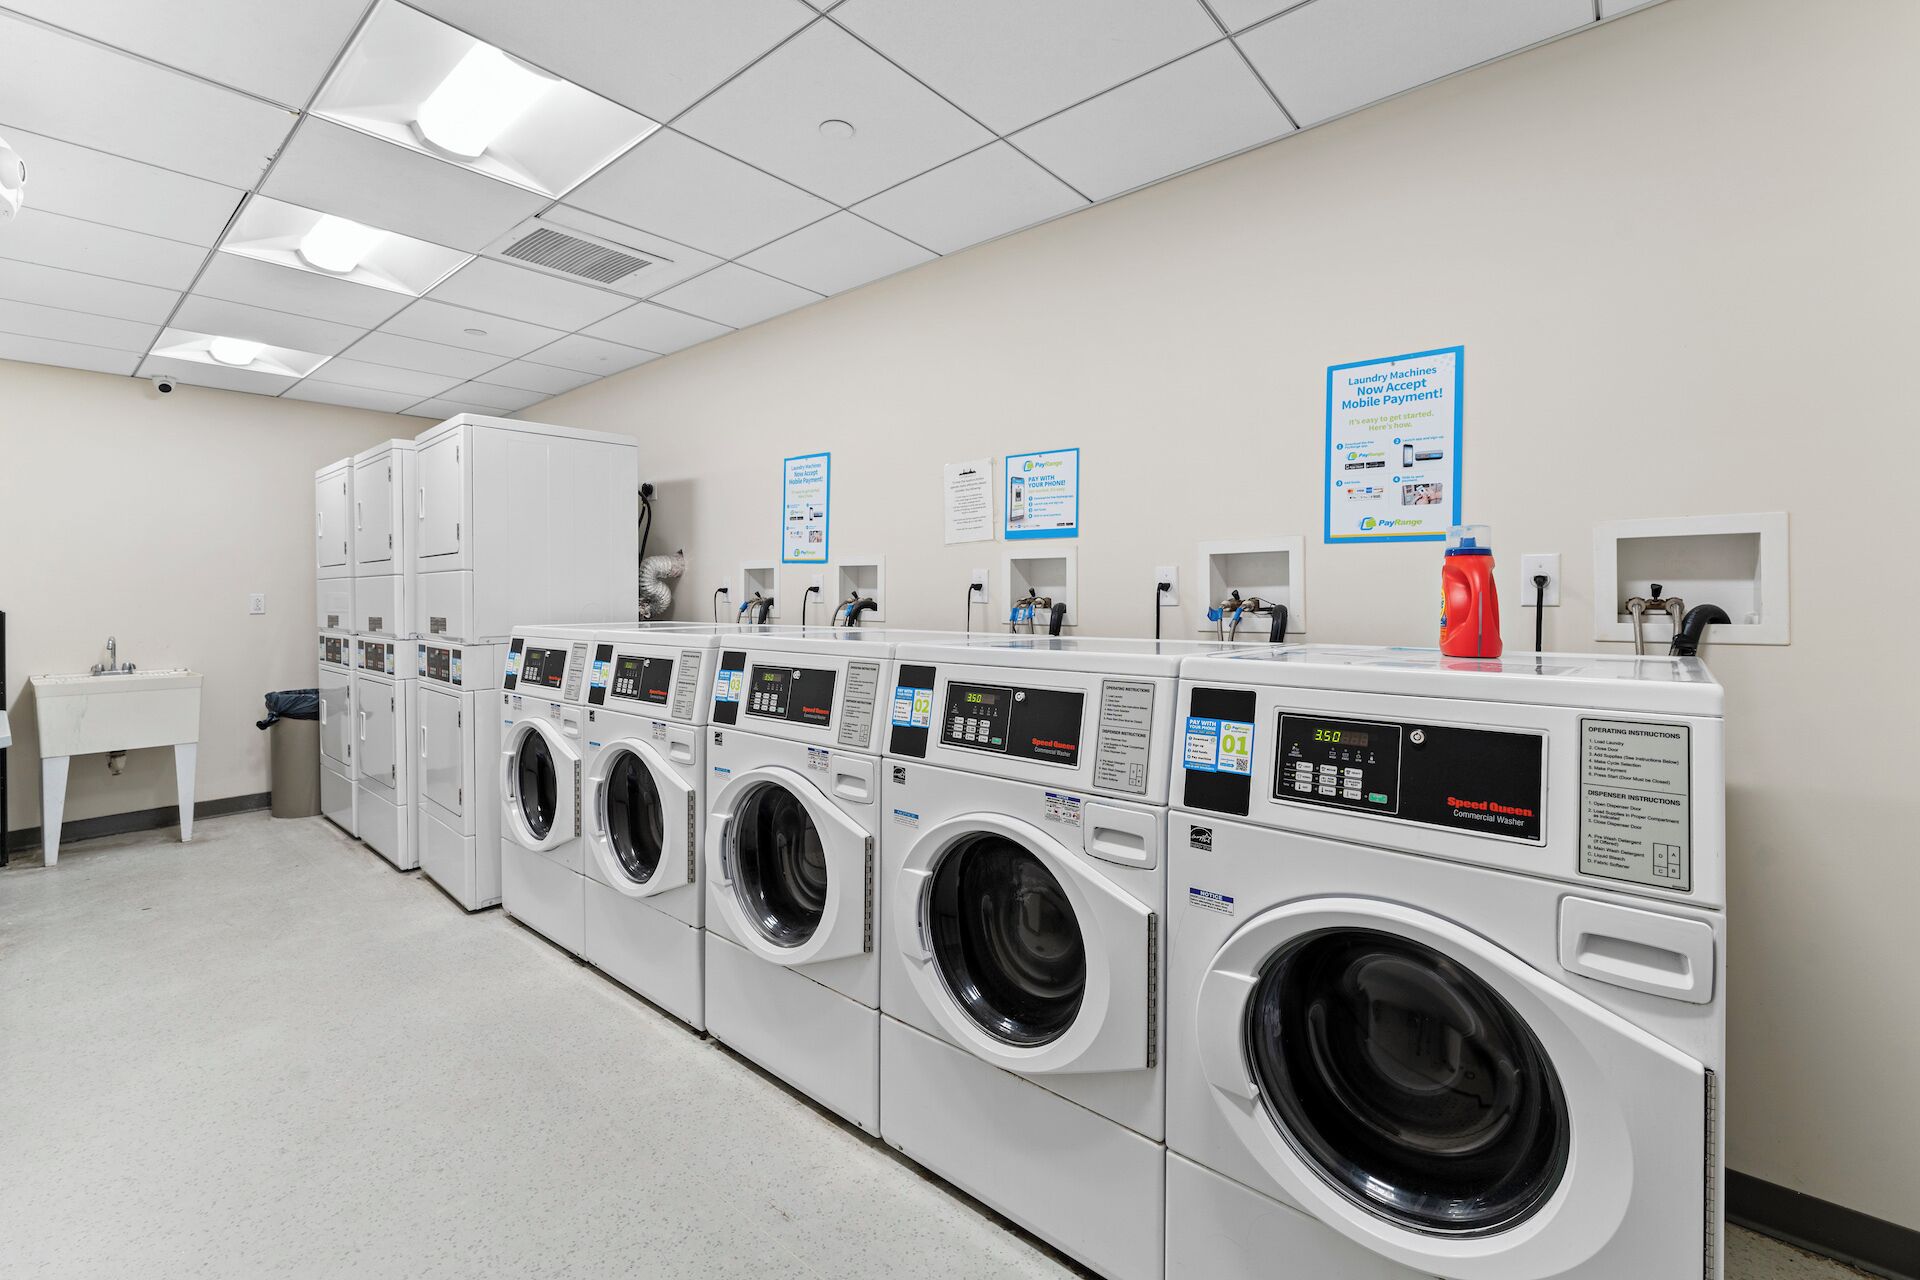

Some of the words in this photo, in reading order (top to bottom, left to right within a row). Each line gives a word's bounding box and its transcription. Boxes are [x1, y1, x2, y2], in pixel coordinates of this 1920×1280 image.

[1348, 374, 1387, 386] Laundry
[1390, 367, 1437, 379] Machines
[1357, 386, 1384, 396] Now
[1386, 378, 1427, 392] Accept
[1342, 397, 1380, 410] Mobile
[1384, 388, 1443, 406] Payment!
[1361, 417, 1379, 425] easy
[1390, 414, 1402, 423] get
[1404, 410, 1434, 420] started.
[1369, 423, 1392, 431] Here's
[1379, 519, 1422, 528] PayRange
[915, 698, 929, 713] 02
[1314, 730, 1341, 742] 3.50
[1629, 729, 1680, 739] INSTRUCTIONS
[1032, 738, 1053, 747] Speed
[1222, 734, 1248, 755] 01
[1588, 790, 1626, 800] DISPENSER
[1628, 794, 1680, 806] INSTRUCTIONS
[1447, 796, 1488, 811] Speed
[1489, 802, 1533, 817] Queen
[1453, 809, 1495, 822] Commercial
[1497, 815, 1524, 826] Washer
[1648, 816, 1679, 824] Compartment
[1200, 890, 1222, 901] NOTICE
